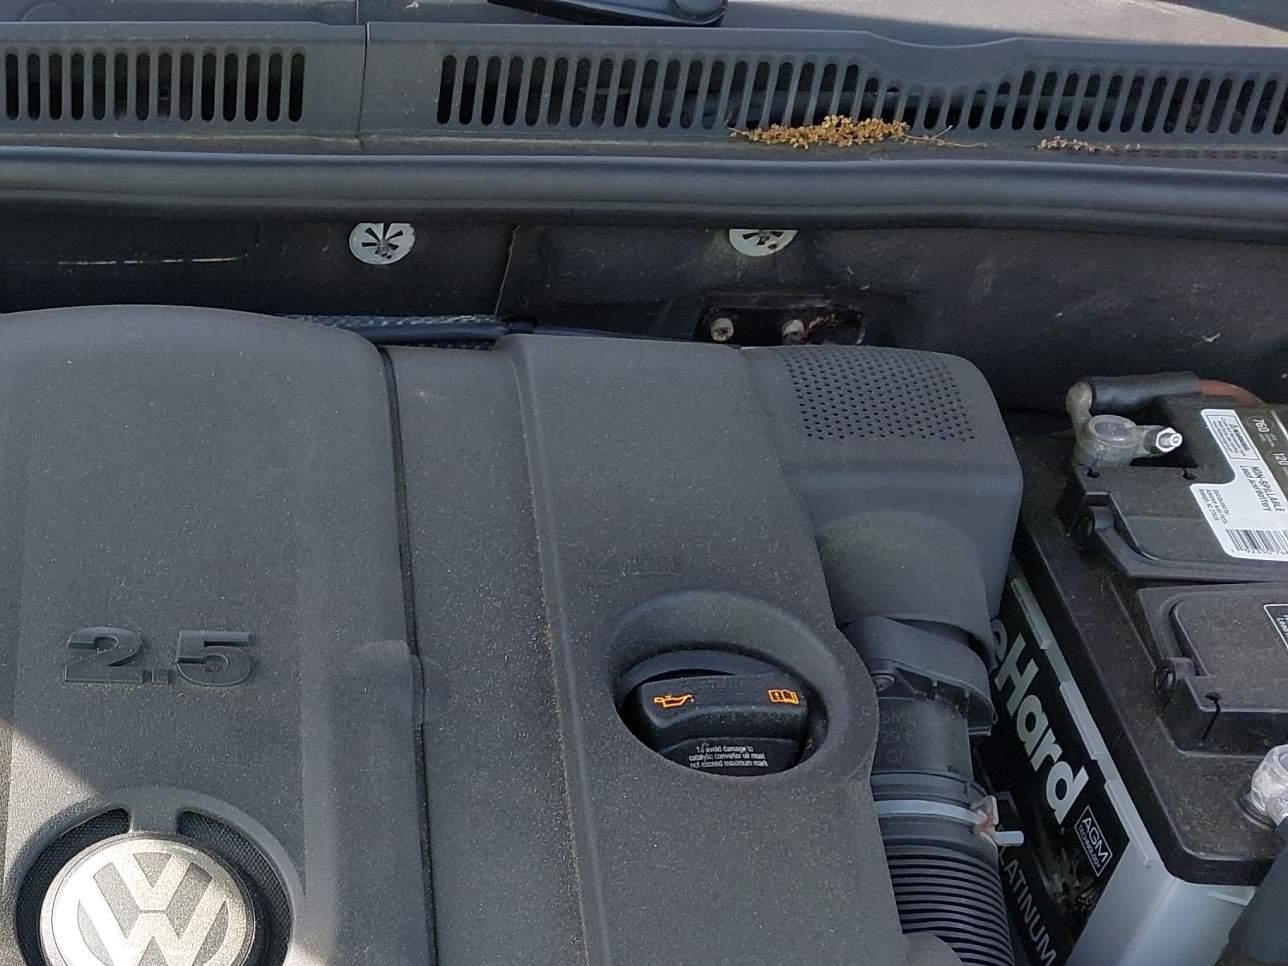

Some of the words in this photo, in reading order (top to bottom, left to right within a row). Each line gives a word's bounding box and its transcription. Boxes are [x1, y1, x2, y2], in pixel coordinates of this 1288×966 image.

[63, 625, 253, 687] 2.5
[723, 745, 746, 753] damage
[1081, 817, 1108, 863] AGM
